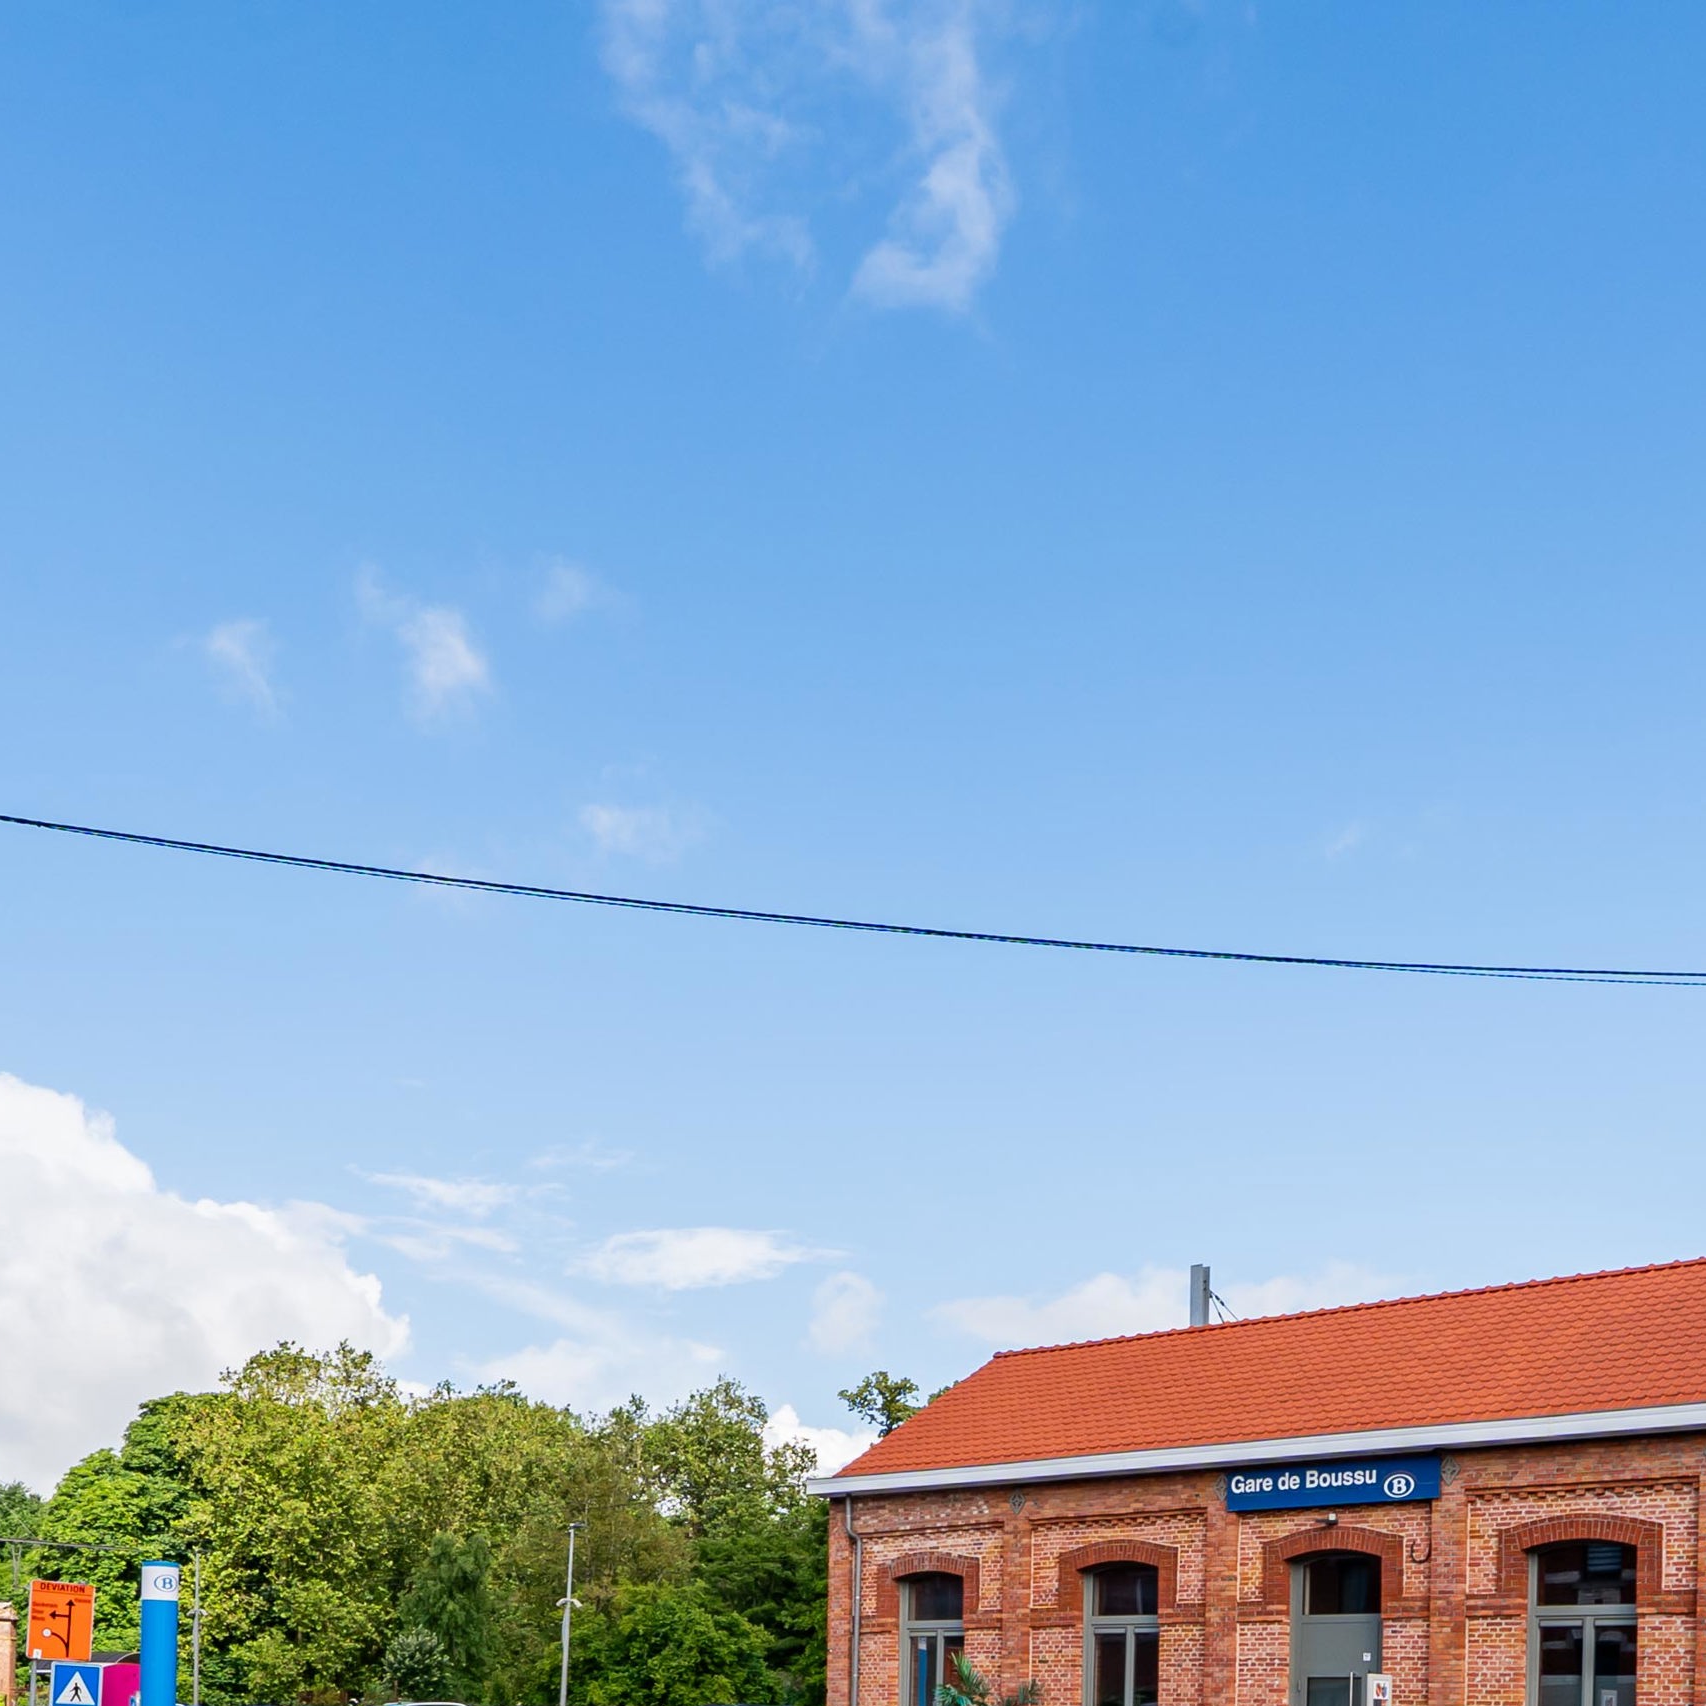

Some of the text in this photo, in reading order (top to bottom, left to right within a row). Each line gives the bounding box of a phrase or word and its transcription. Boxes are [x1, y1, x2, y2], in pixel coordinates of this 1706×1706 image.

[1231, 1469, 1377, 1494] Gare de Boussu
